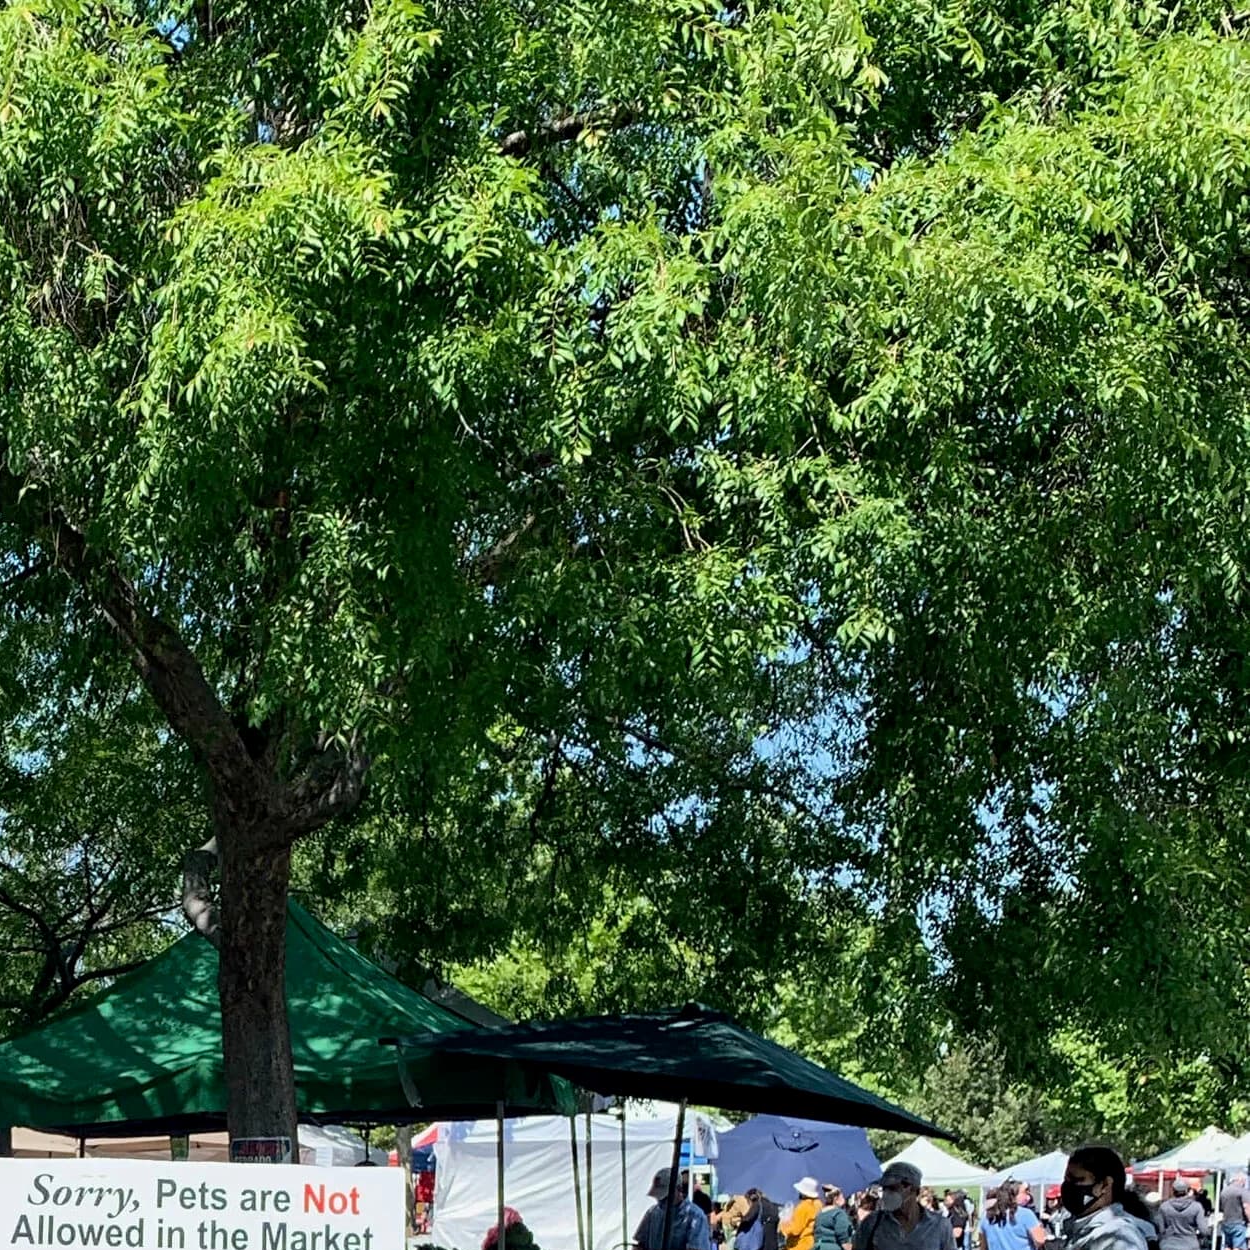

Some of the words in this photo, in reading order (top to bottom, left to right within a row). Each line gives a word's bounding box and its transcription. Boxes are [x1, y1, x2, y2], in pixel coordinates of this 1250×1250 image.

[27, 1173, 141, 1219] Sorry,
[157, 1179, 227, 1210] Pets
[240, 1190, 290, 1212] are
[304, 1184, 359, 1215] Not
[11, 1213, 144, 1247] Allowed
[158, 1219, 184, 1248] in
[198, 1220, 248, 1250] the
